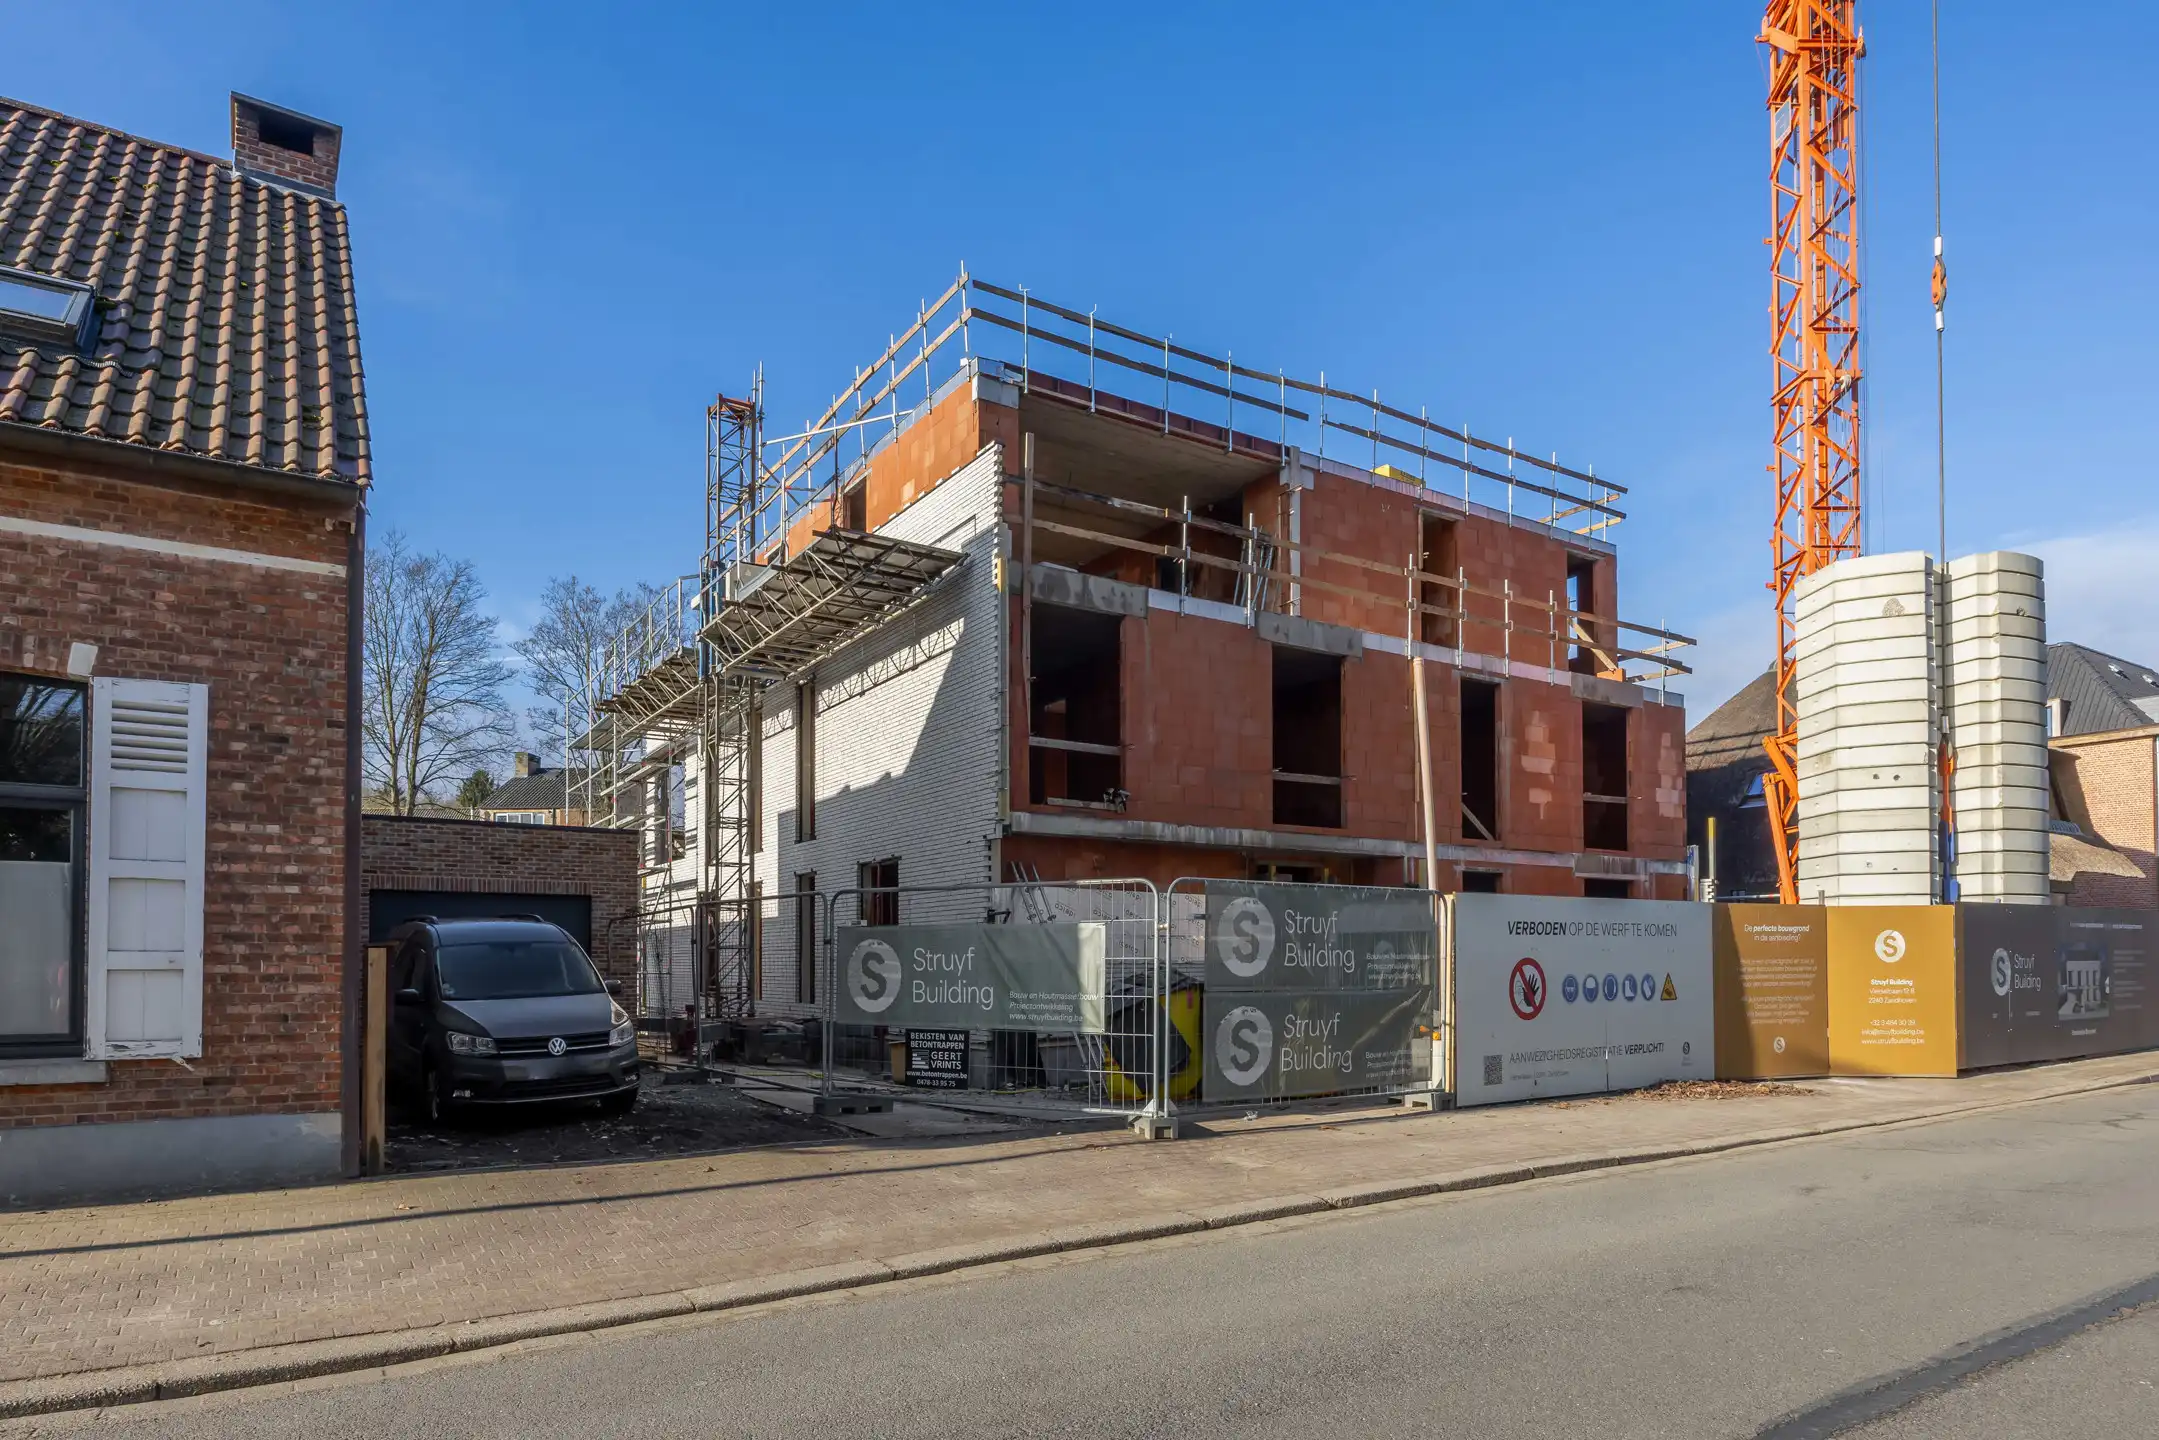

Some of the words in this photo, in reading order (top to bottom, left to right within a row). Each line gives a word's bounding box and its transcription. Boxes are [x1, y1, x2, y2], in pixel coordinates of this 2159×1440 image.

[1284, 909, 1338, 940] Struyf
[1507, 921, 1567, 936] VERBODEN
[1569, 921, 1584, 936] OP
[1586, 922, 1599, 937] DE
[1602, 923, 1629, 937] WERF
[1629, 923, 1642, 937] TE
[1644, 924, 1677, 937] KOMEN
[1744, 924, 1752, 932] De
[1753, 924, 1777, 933] perfecte
[1777, 924, 1810, 933] bouwgrond
[912, 947, 975, 976] Struyf
[1284, 942, 1355, 973] Building
[2014, 953, 2035, 971] Struyf
[1890, 978, 1913, 986] Building
[2014, 973, 2041, 991] Building
[912, 981, 994, 1010] Building
[1009, 991, 1028, 999] Bouw
[1283, 1012, 1341, 1042] Struyf
[910, 1032, 946, 1040] BEKISTEN
[948, 1033, 965, 1041] VAN
[910, 1041, 965, 1050] BETONTRAPPEN
[1624, 1042, 1664, 1055] VERPLICHT!
[930, 1051, 962, 1060] GEERT
[1280, 1046, 1353, 1073] Building
[930, 1060, 962, 1070] VRINTS
[906, 1070, 968, 1079] www.betontrappen.be
